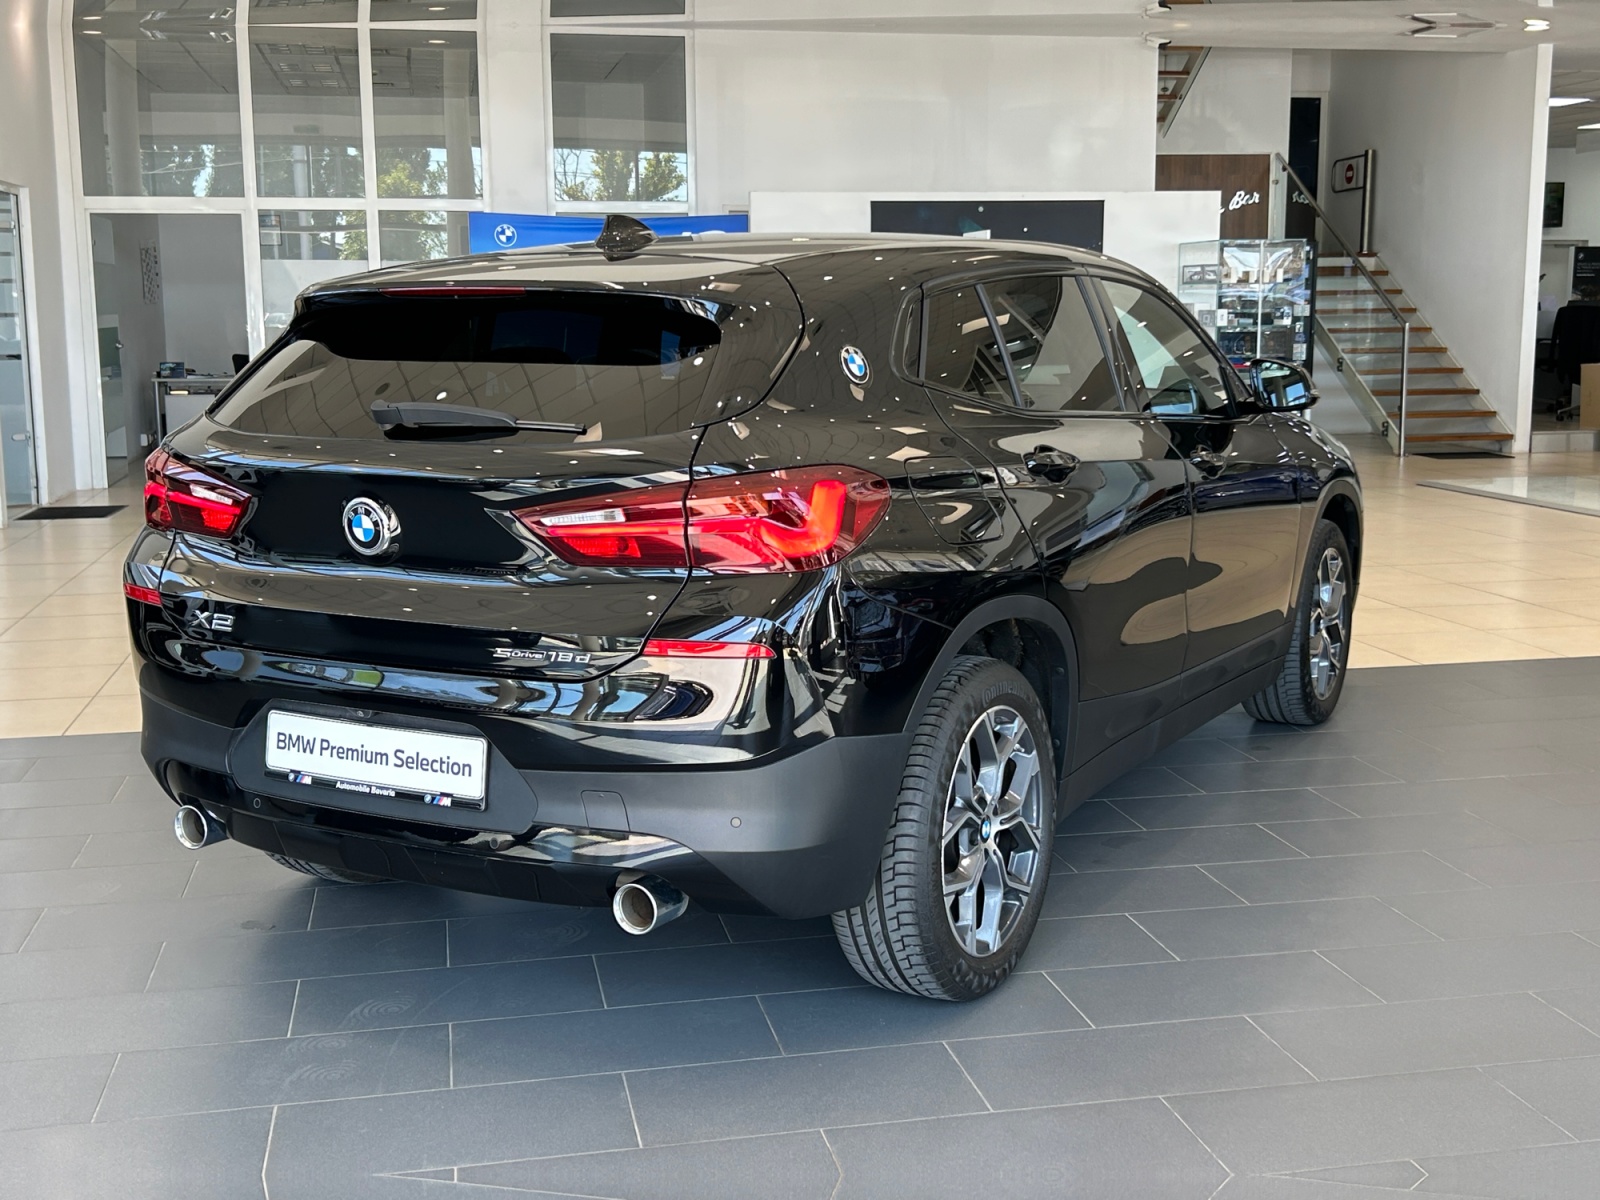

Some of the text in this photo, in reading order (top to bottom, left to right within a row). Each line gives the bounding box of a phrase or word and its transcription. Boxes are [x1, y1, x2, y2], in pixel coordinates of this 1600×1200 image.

[190, 609, 234, 632] X2
[276, 732, 472, 777] BMW Premium Selection
[336, 781, 396, 797] Automobile Bavaria
